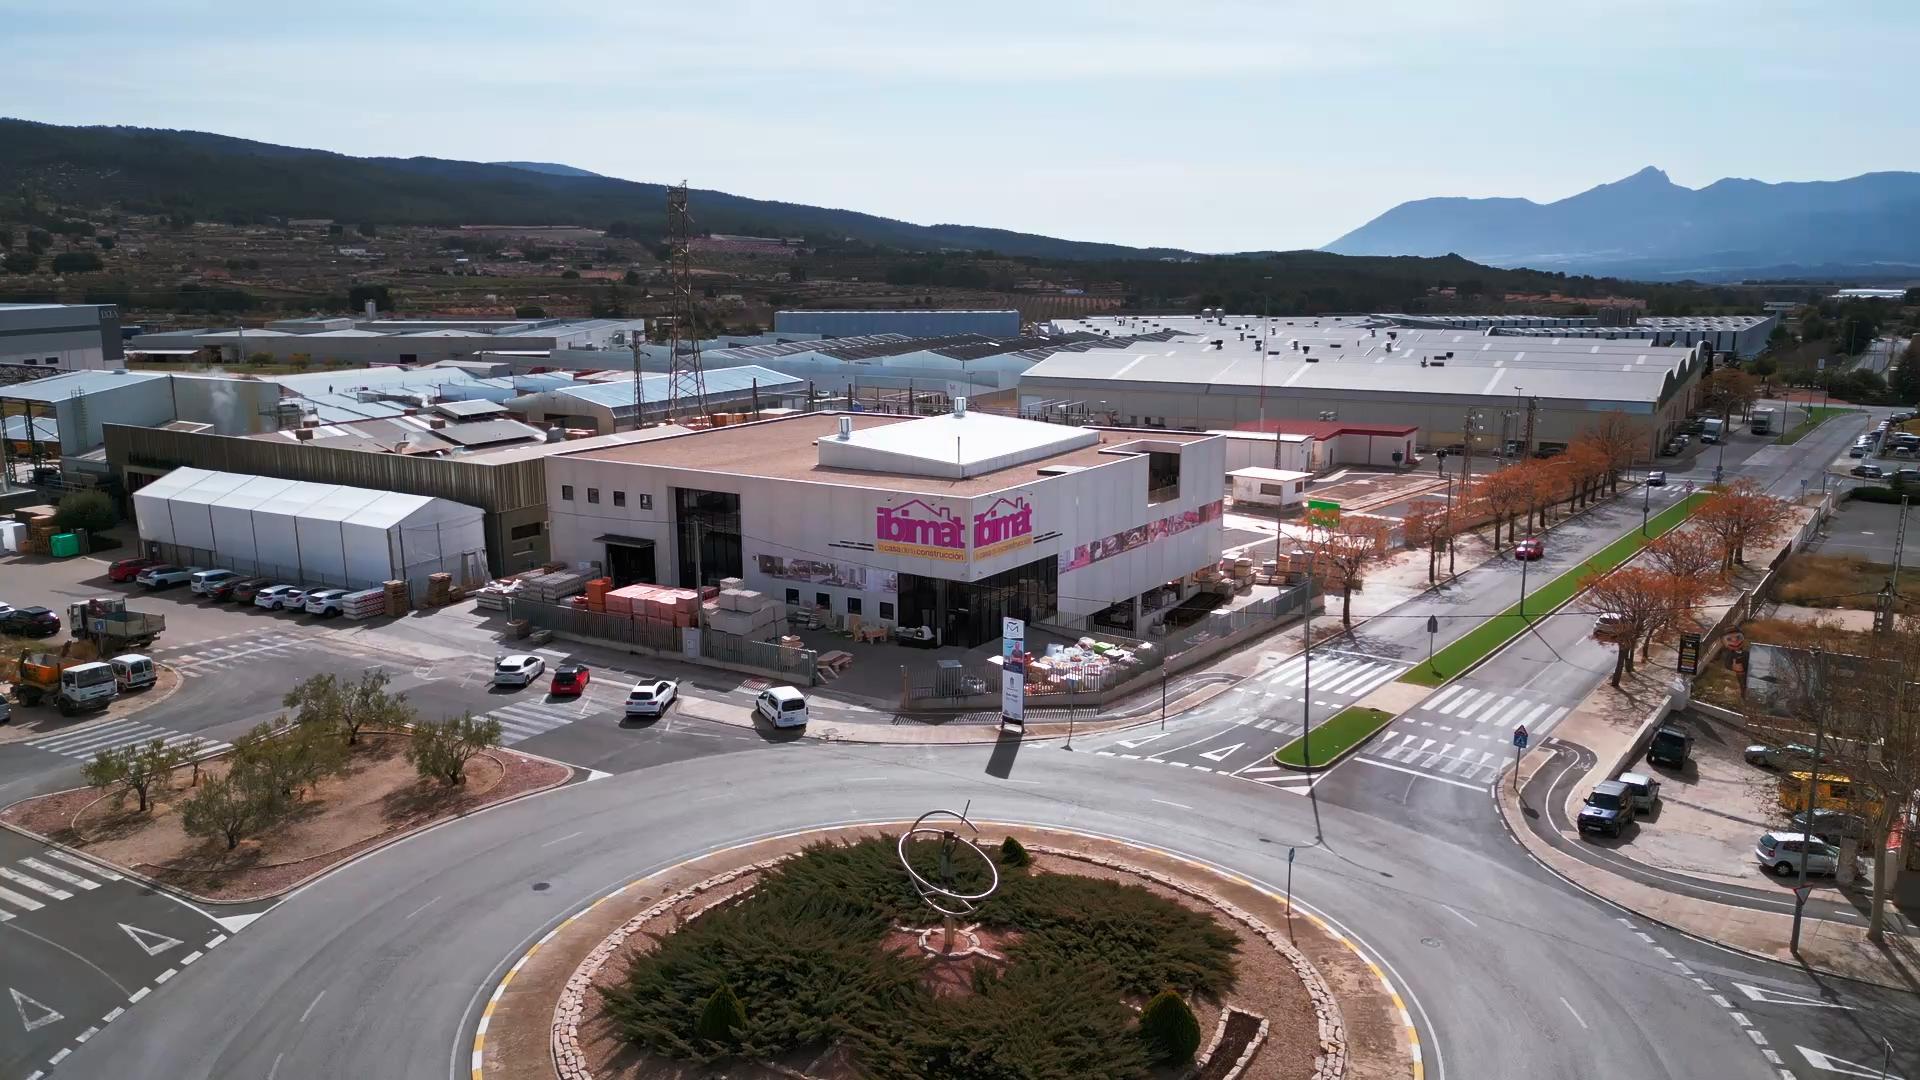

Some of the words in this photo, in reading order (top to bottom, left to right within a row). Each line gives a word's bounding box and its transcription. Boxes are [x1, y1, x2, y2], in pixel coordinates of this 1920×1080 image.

[877, 507, 965, 549] ibimat
[974, 503, 1032, 548] ibimat
[884, 545, 901, 553] casa
[916, 548, 964, 561] construcción
